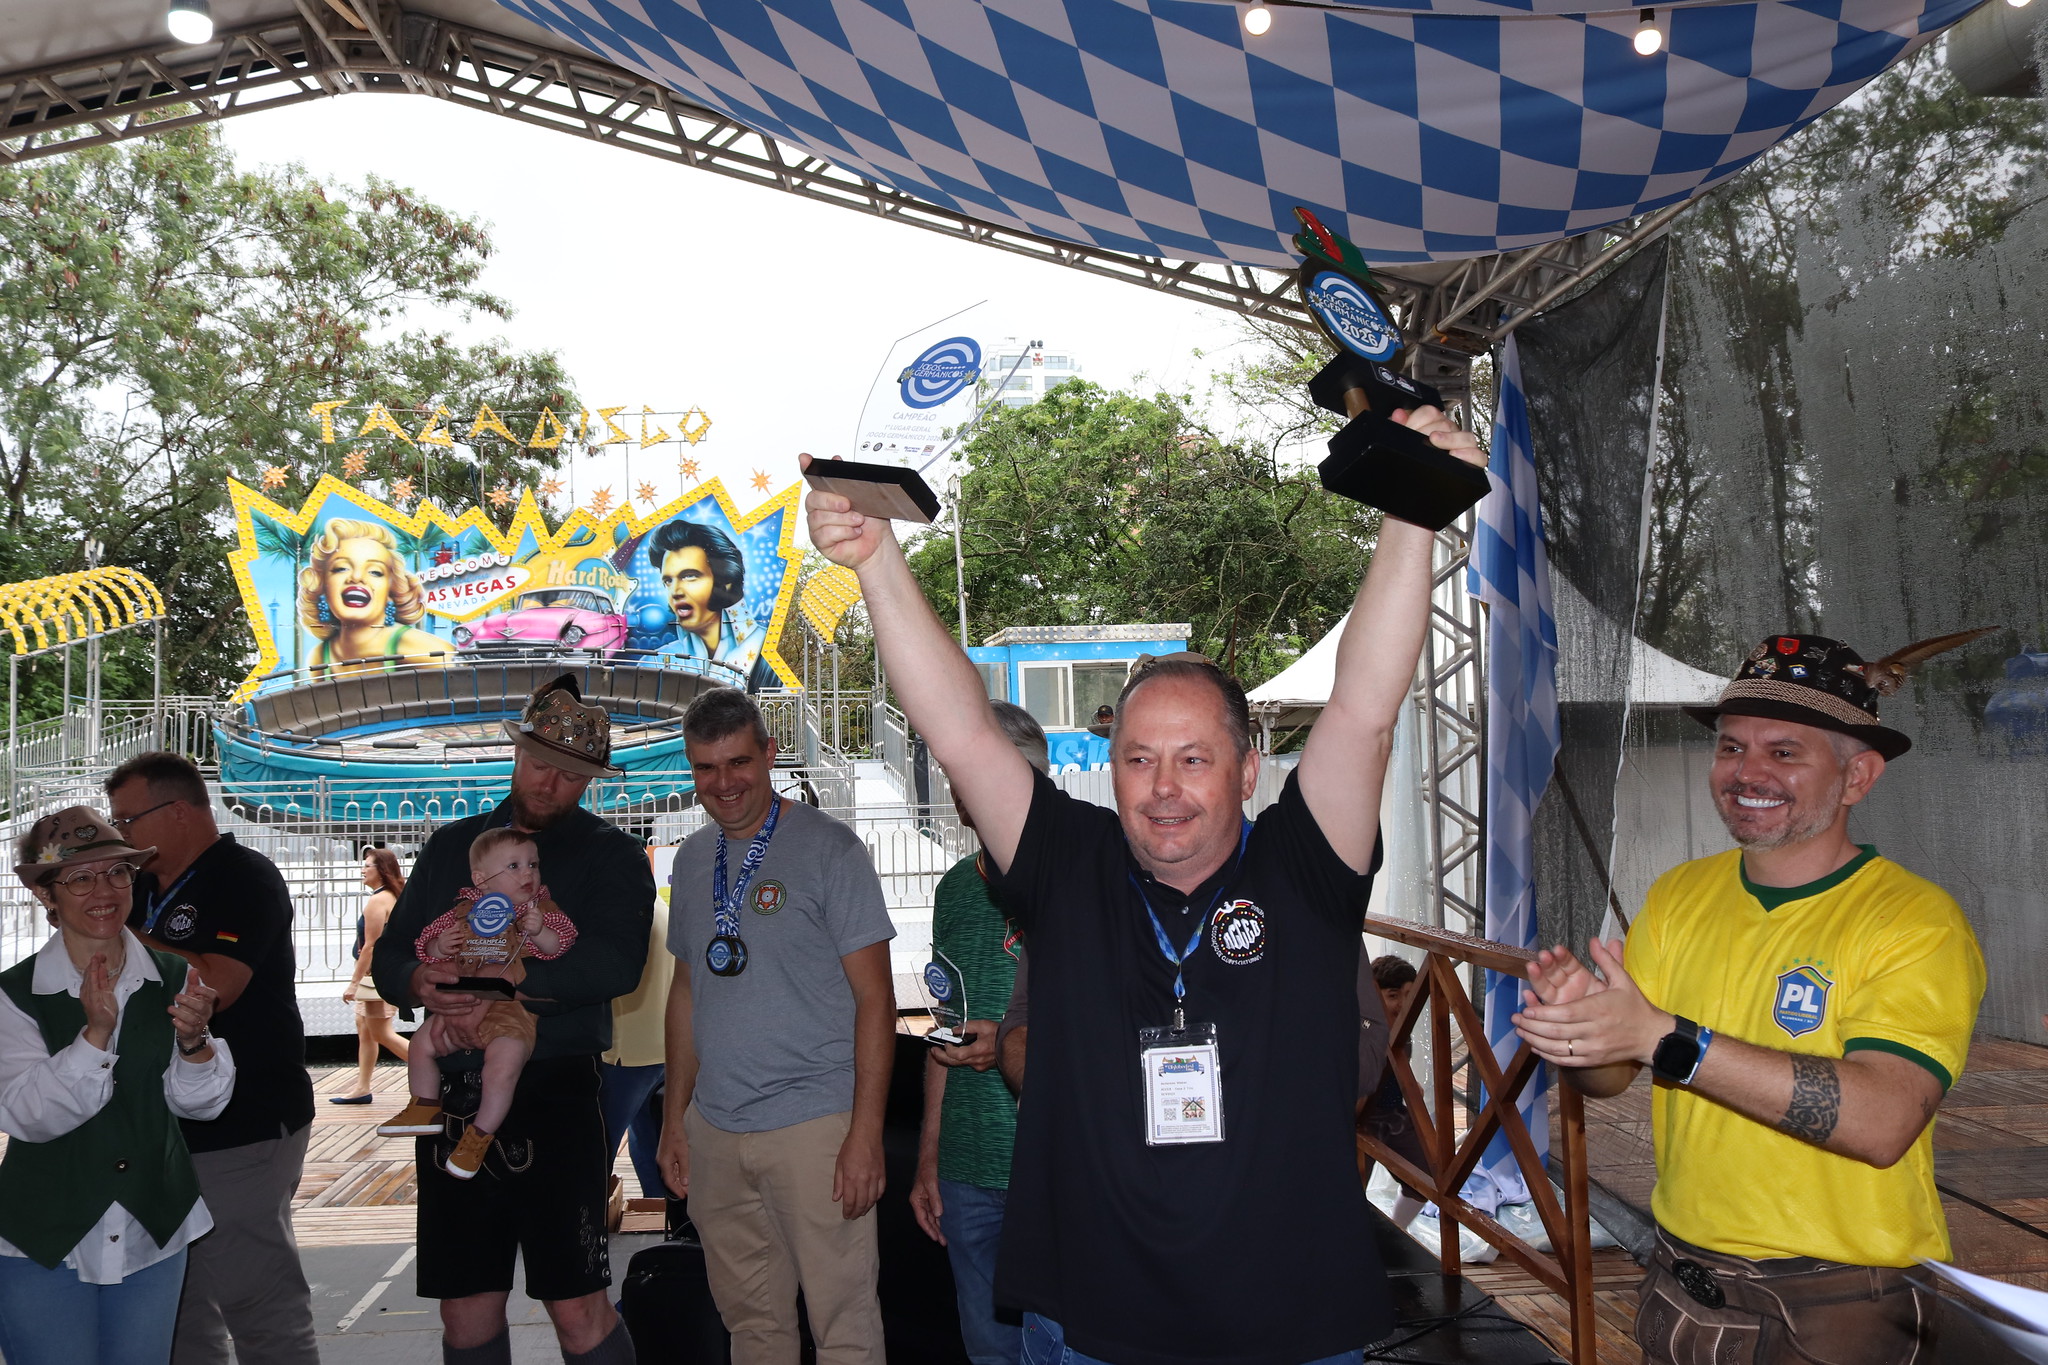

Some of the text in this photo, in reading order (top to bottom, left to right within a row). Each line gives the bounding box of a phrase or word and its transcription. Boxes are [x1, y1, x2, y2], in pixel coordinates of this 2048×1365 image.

[1323, 291, 1350, 310] JOGOS
[1340, 320, 1378, 347] 2026
[917, 363, 942, 372] JOGOS
[892, 411, 937, 421] CAMPEÃO
[417, 553, 506, 581] WELCOME
[547, 560, 597, 586] Hard
[452, 575, 516, 598] VEGAS
[438, 595, 487, 610] NEVADA
[1793, 667, 1806, 675] PL
[1781, 983, 1819, 1013] PL
